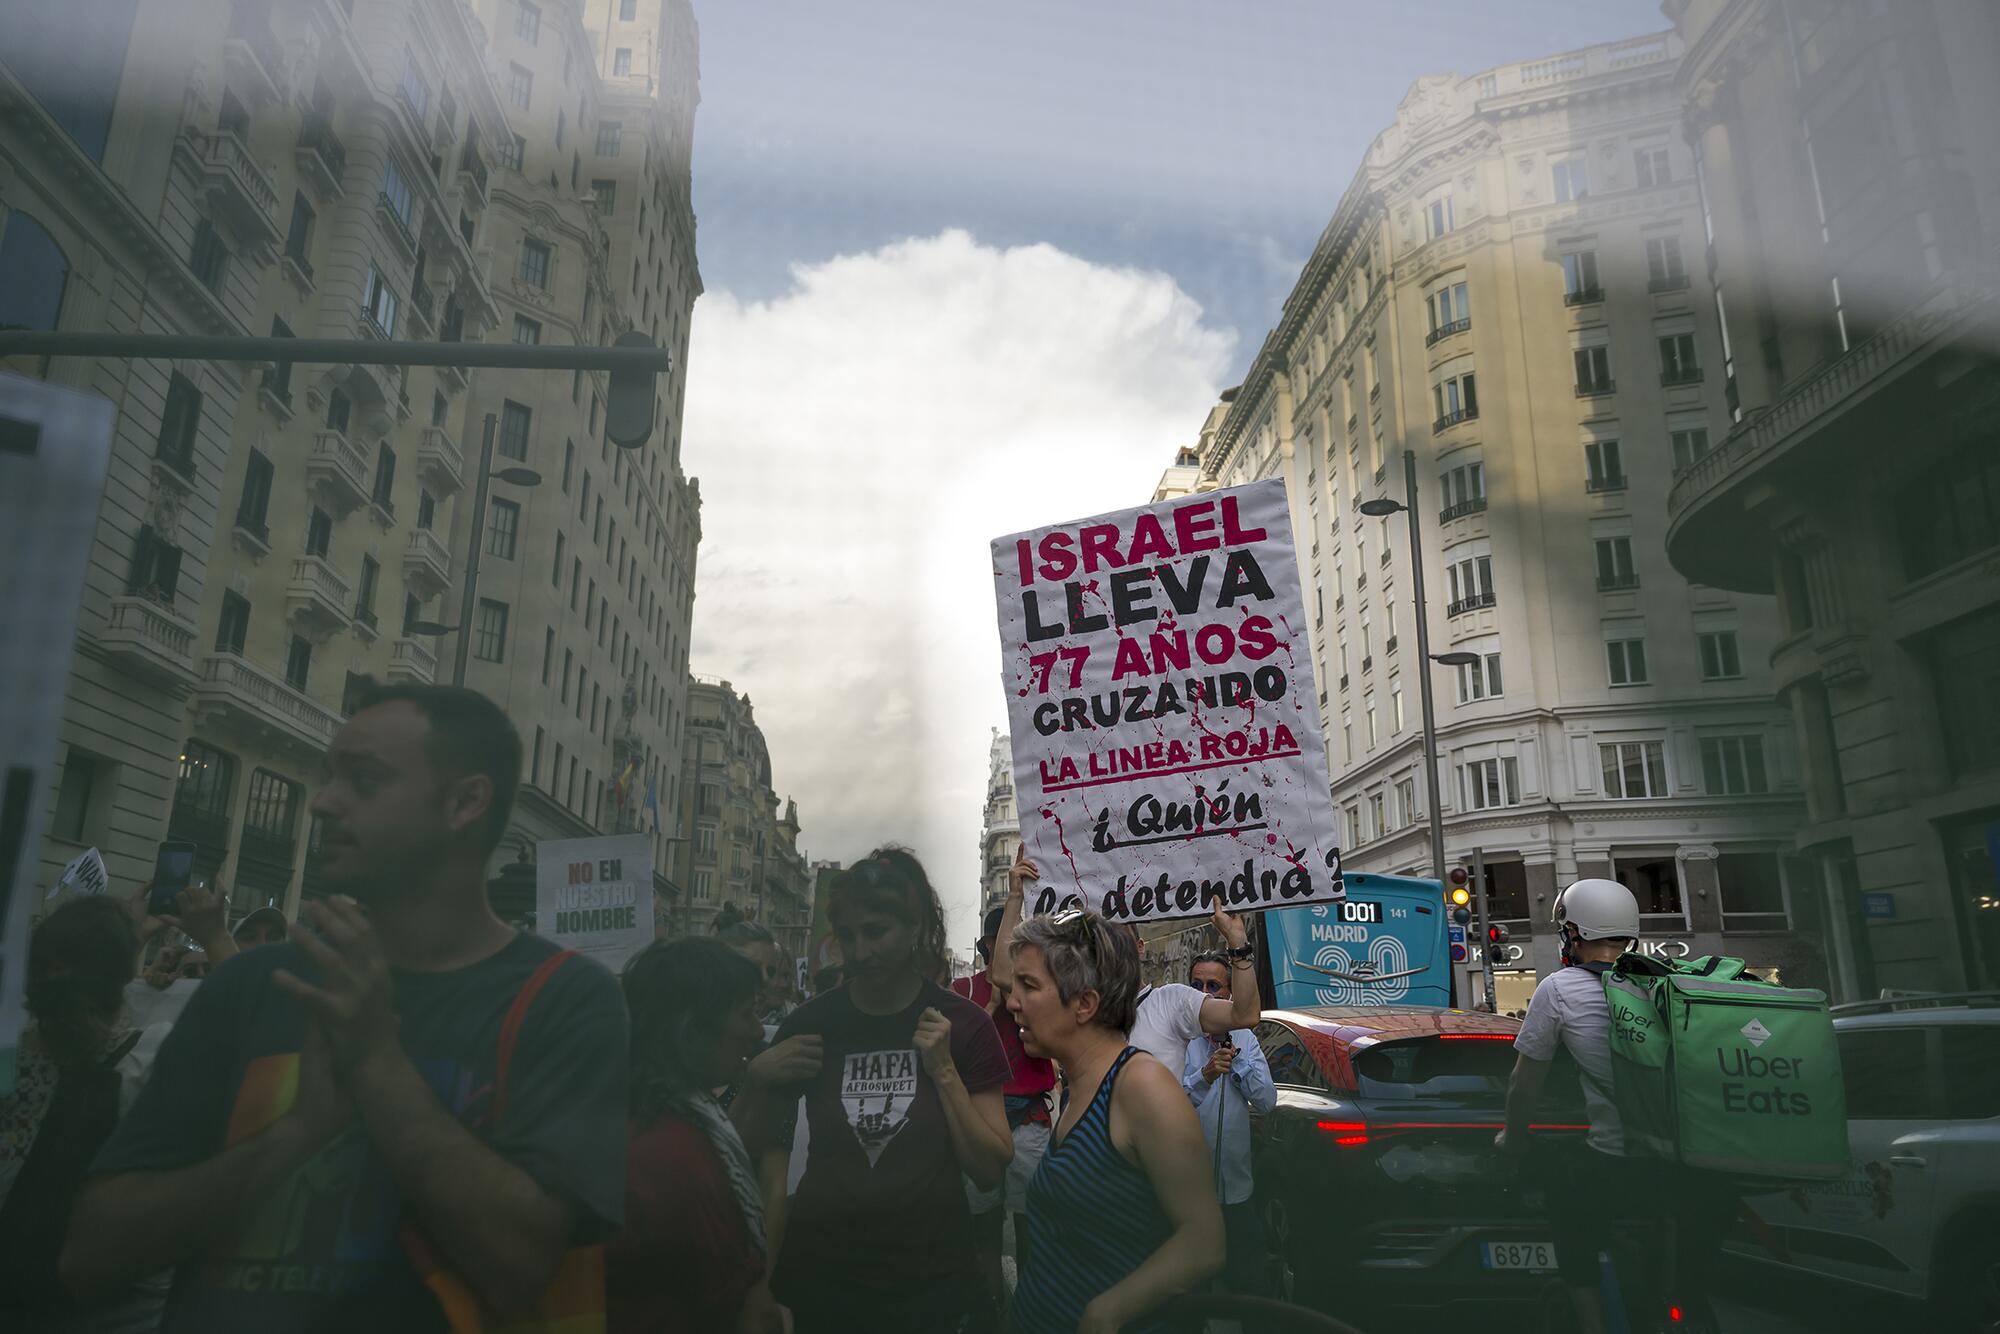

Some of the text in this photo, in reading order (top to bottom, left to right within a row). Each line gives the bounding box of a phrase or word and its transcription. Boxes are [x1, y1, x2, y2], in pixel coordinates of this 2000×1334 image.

[1016, 496, 1267, 586] ISRAEL
[1021, 549, 1275, 642] LLEVA
[1029, 612, 1279, 694] 77 AÑOS
[1033, 665, 1287, 736] CRUZANDO
[1039, 724, 1298, 785] LA LINEA ROJA
[568, 859, 622, 885] NO EN
[554, 880, 636, 910] NUESTRO
[556, 906, 637, 934] NOMBRE
[1344, 902, 1407, 922] 001 141
[1311, 923, 1369, 943] MADRID
[1613, 1003, 1656, 1029] Uber
[851, 1051, 914, 1080] HAFA
[1716, 1047, 1803, 1079] Uber
[846, 1079, 915, 1093] AFROSWEET
[1721, 1082, 1812, 1116] Eats
[1494, 1245, 1549, 1267] 6876
